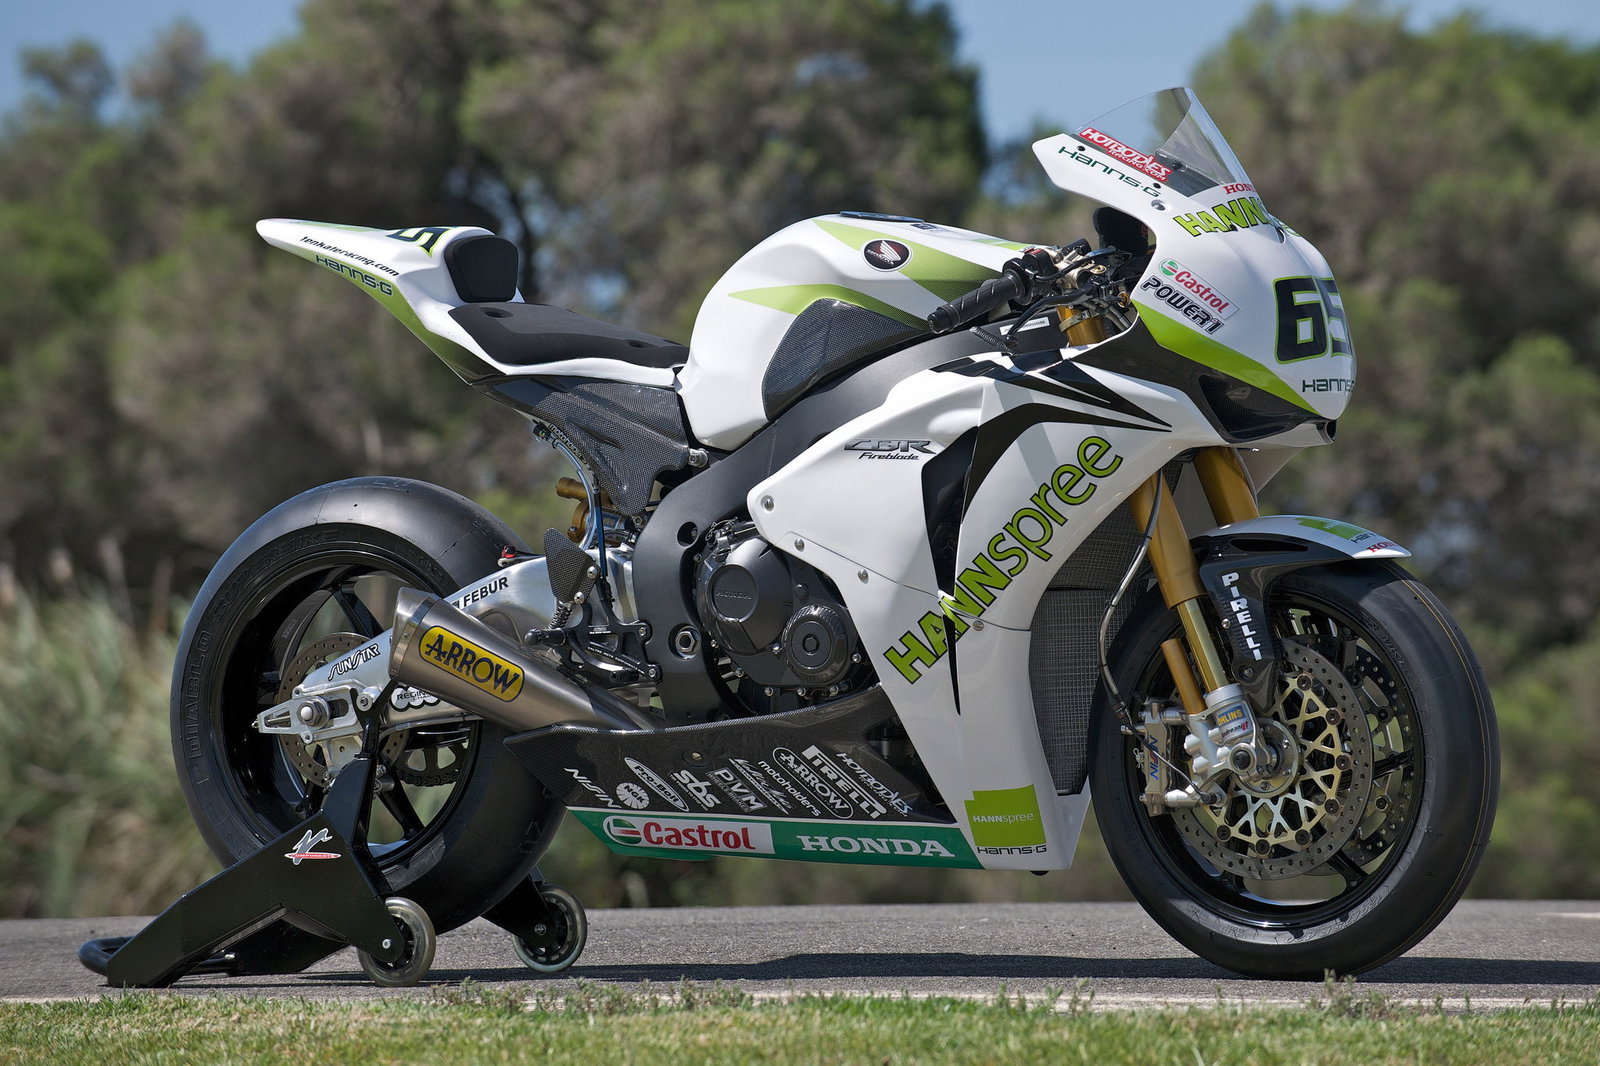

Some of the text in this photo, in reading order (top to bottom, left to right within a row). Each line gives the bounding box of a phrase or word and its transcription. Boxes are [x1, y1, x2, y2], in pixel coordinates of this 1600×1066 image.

[1080, 128, 1172, 177] HOTBODIES
[300, 236, 400, 277] tenkateracing.com
[1140, 275, 1225, 334] POWER1
[1174, 271, 1231, 314] Castrol
[844, 439, 937, 455] CBR
[858, 452, 919, 461] Fireblade
[883, 435, 1123, 684] HANNspree
[462, 576, 509, 608] FEBUR
[1221, 571, 1263, 661] PIRELLI
[328, 643, 380, 681] SUNSTAR
[424, 633, 520, 694] ARROW
[624, 785, 646, 803] NGK
[633, 765, 680, 803] Pro-Bolt
[672, 769, 722, 808] sbs
[714, 769, 762, 811] PVM
[758, 760, 821, 817] motoholders
[779, 753, 850, 810] ARROW
[802, 745, 887, 820] PIRELLI
[643, 821, 756, 850] Castrol
[973, 813, 1034, 825] HANNspree
[796, 835, 956, 858] HONDA
